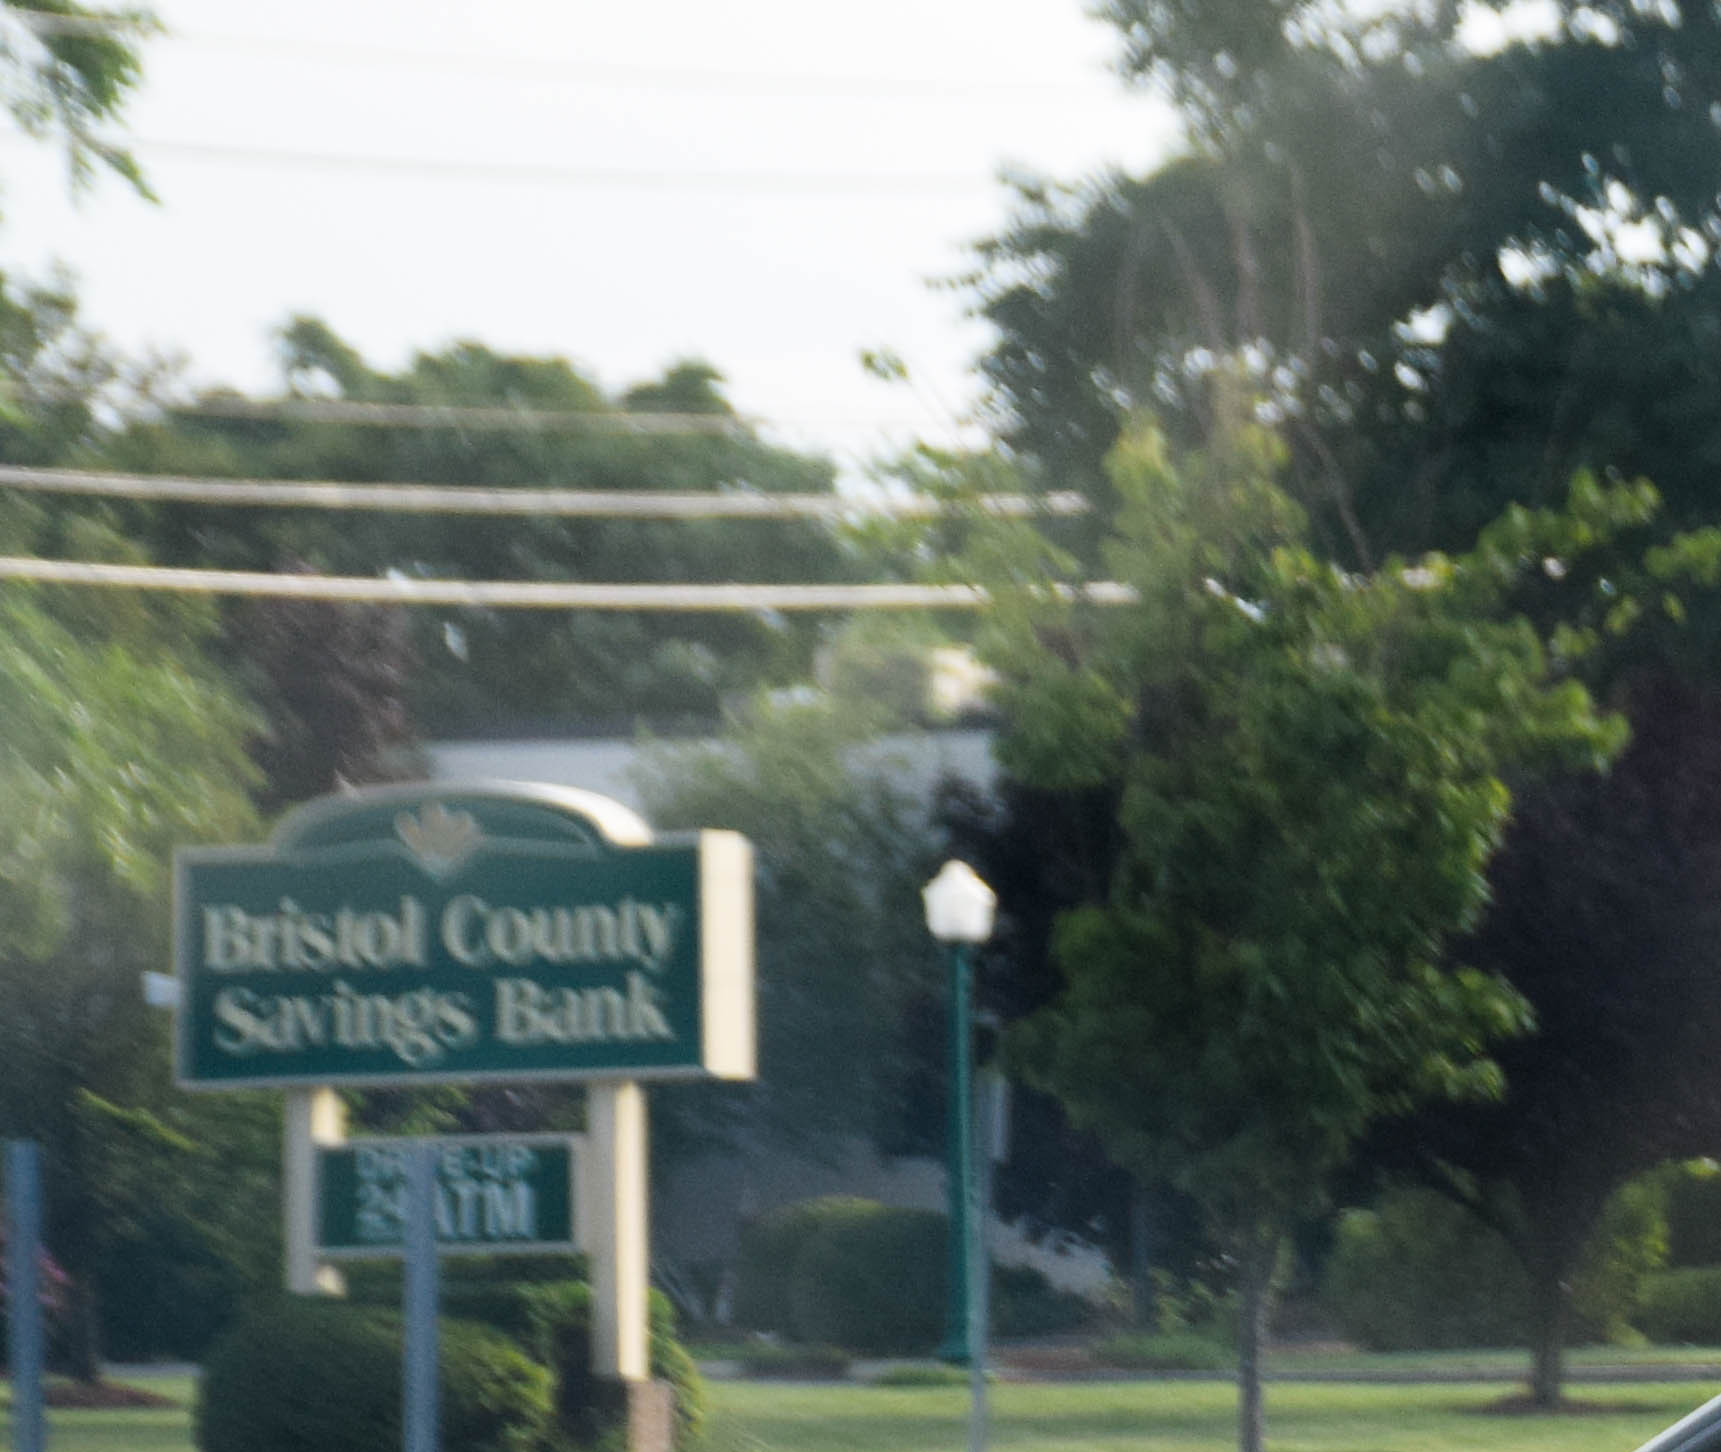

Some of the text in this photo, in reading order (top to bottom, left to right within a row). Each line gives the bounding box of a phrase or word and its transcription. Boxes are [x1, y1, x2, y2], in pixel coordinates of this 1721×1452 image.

[202, 893, 682, 975] Bristol County
[213, 970, 676, 1068] Savings Bank
[356, 1147, 538, 1182] DRE-UP
